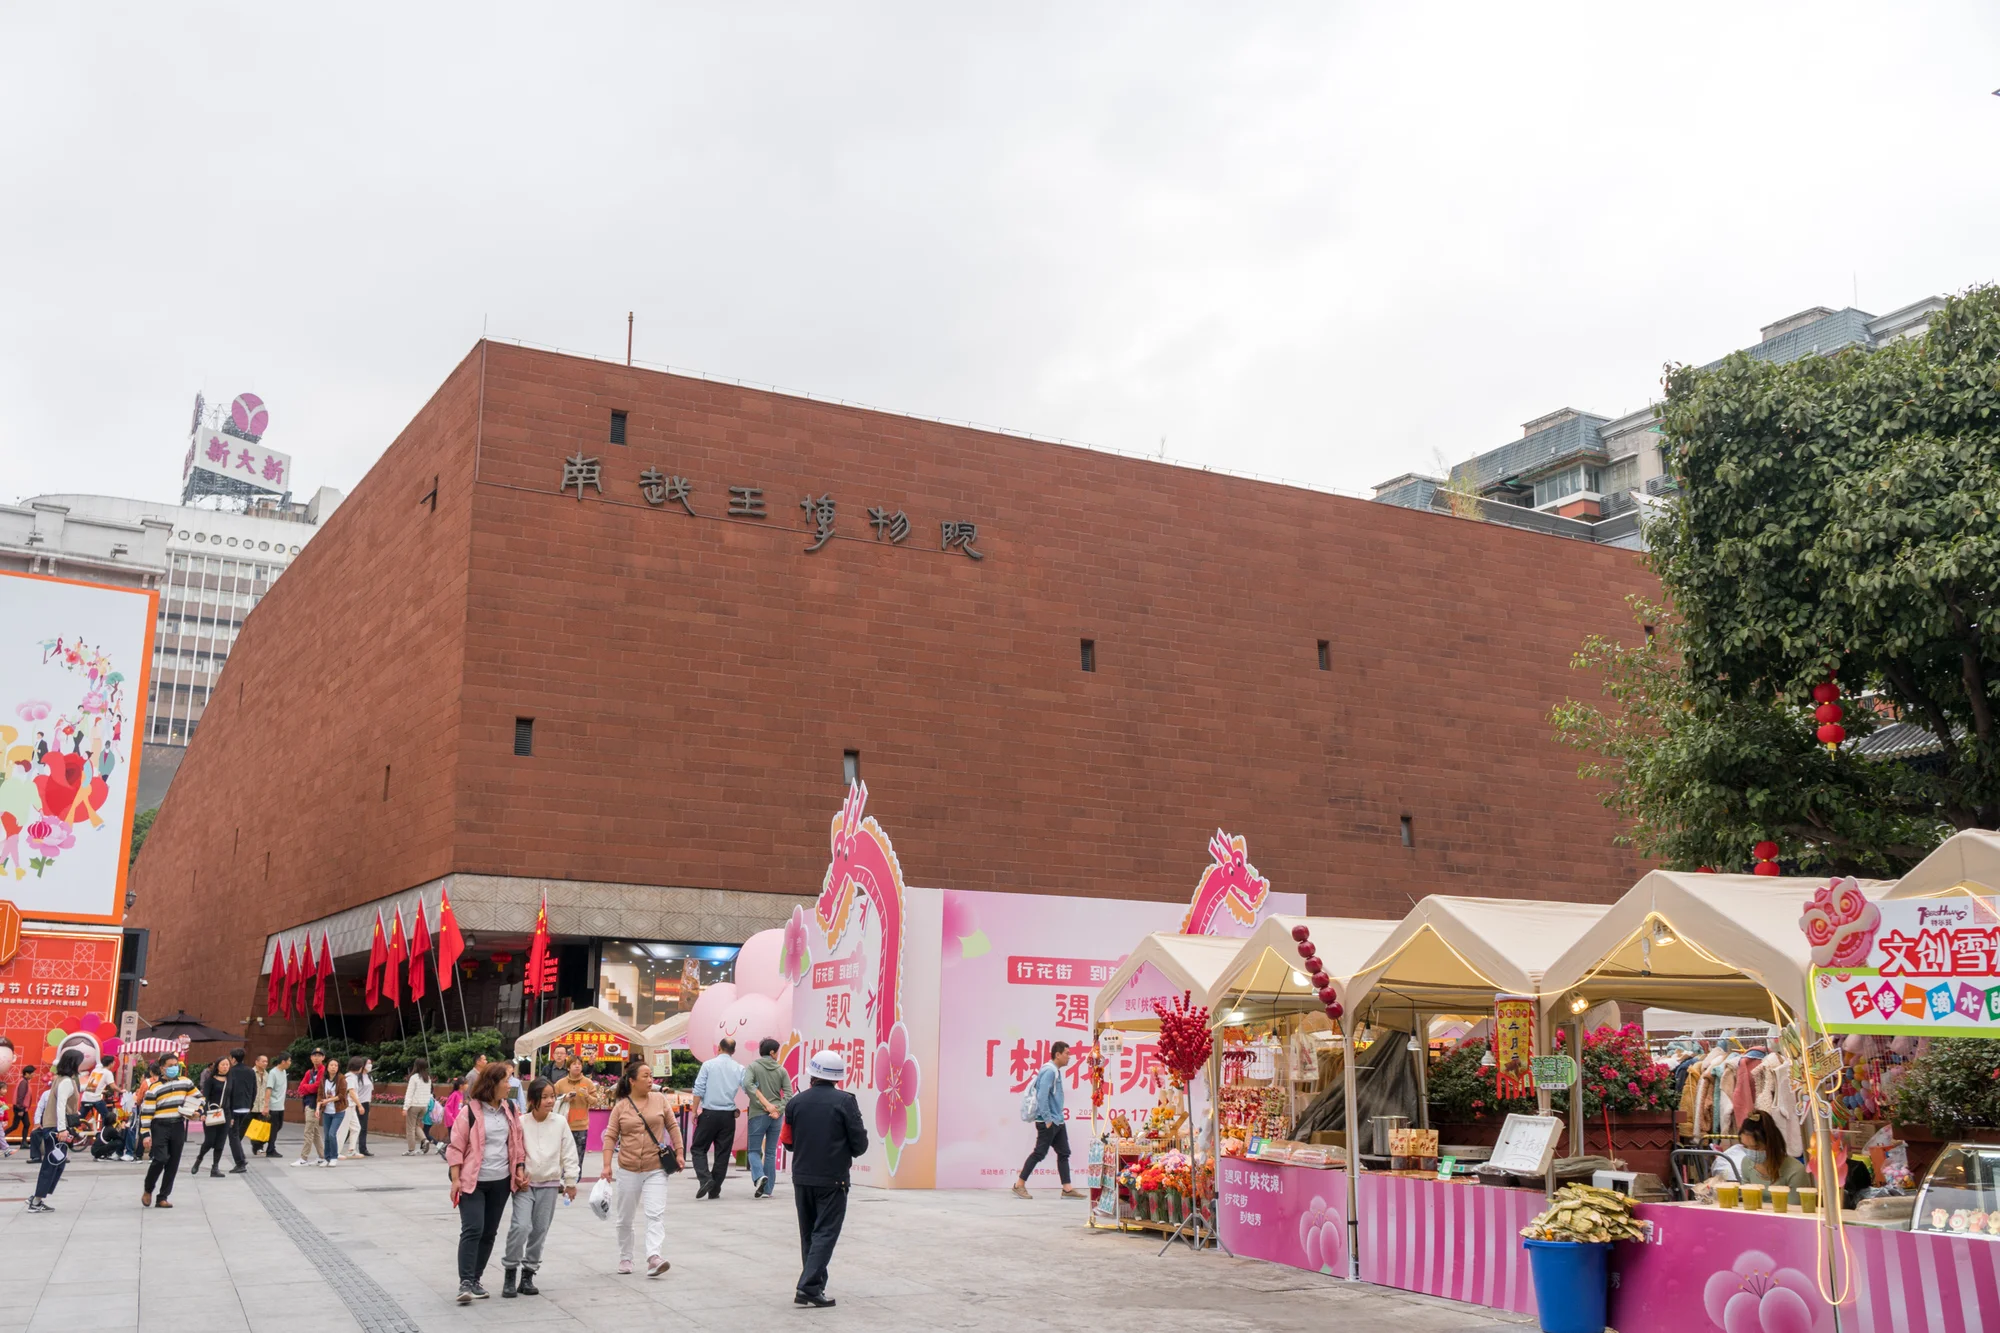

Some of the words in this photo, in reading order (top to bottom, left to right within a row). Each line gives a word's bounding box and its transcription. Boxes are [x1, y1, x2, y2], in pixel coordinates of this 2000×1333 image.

[206, 437, 284, 485] 新大新
[560, 452, 984, 560] 南越王博物院
[1017, 961, 1073, 980] 行花街
[825, 992, 851, 1030] 遇见
[1224, 1169, 1284, 1194] 遇见「桃花源」
[1224, 1192, 1249, 1208] 行花街
